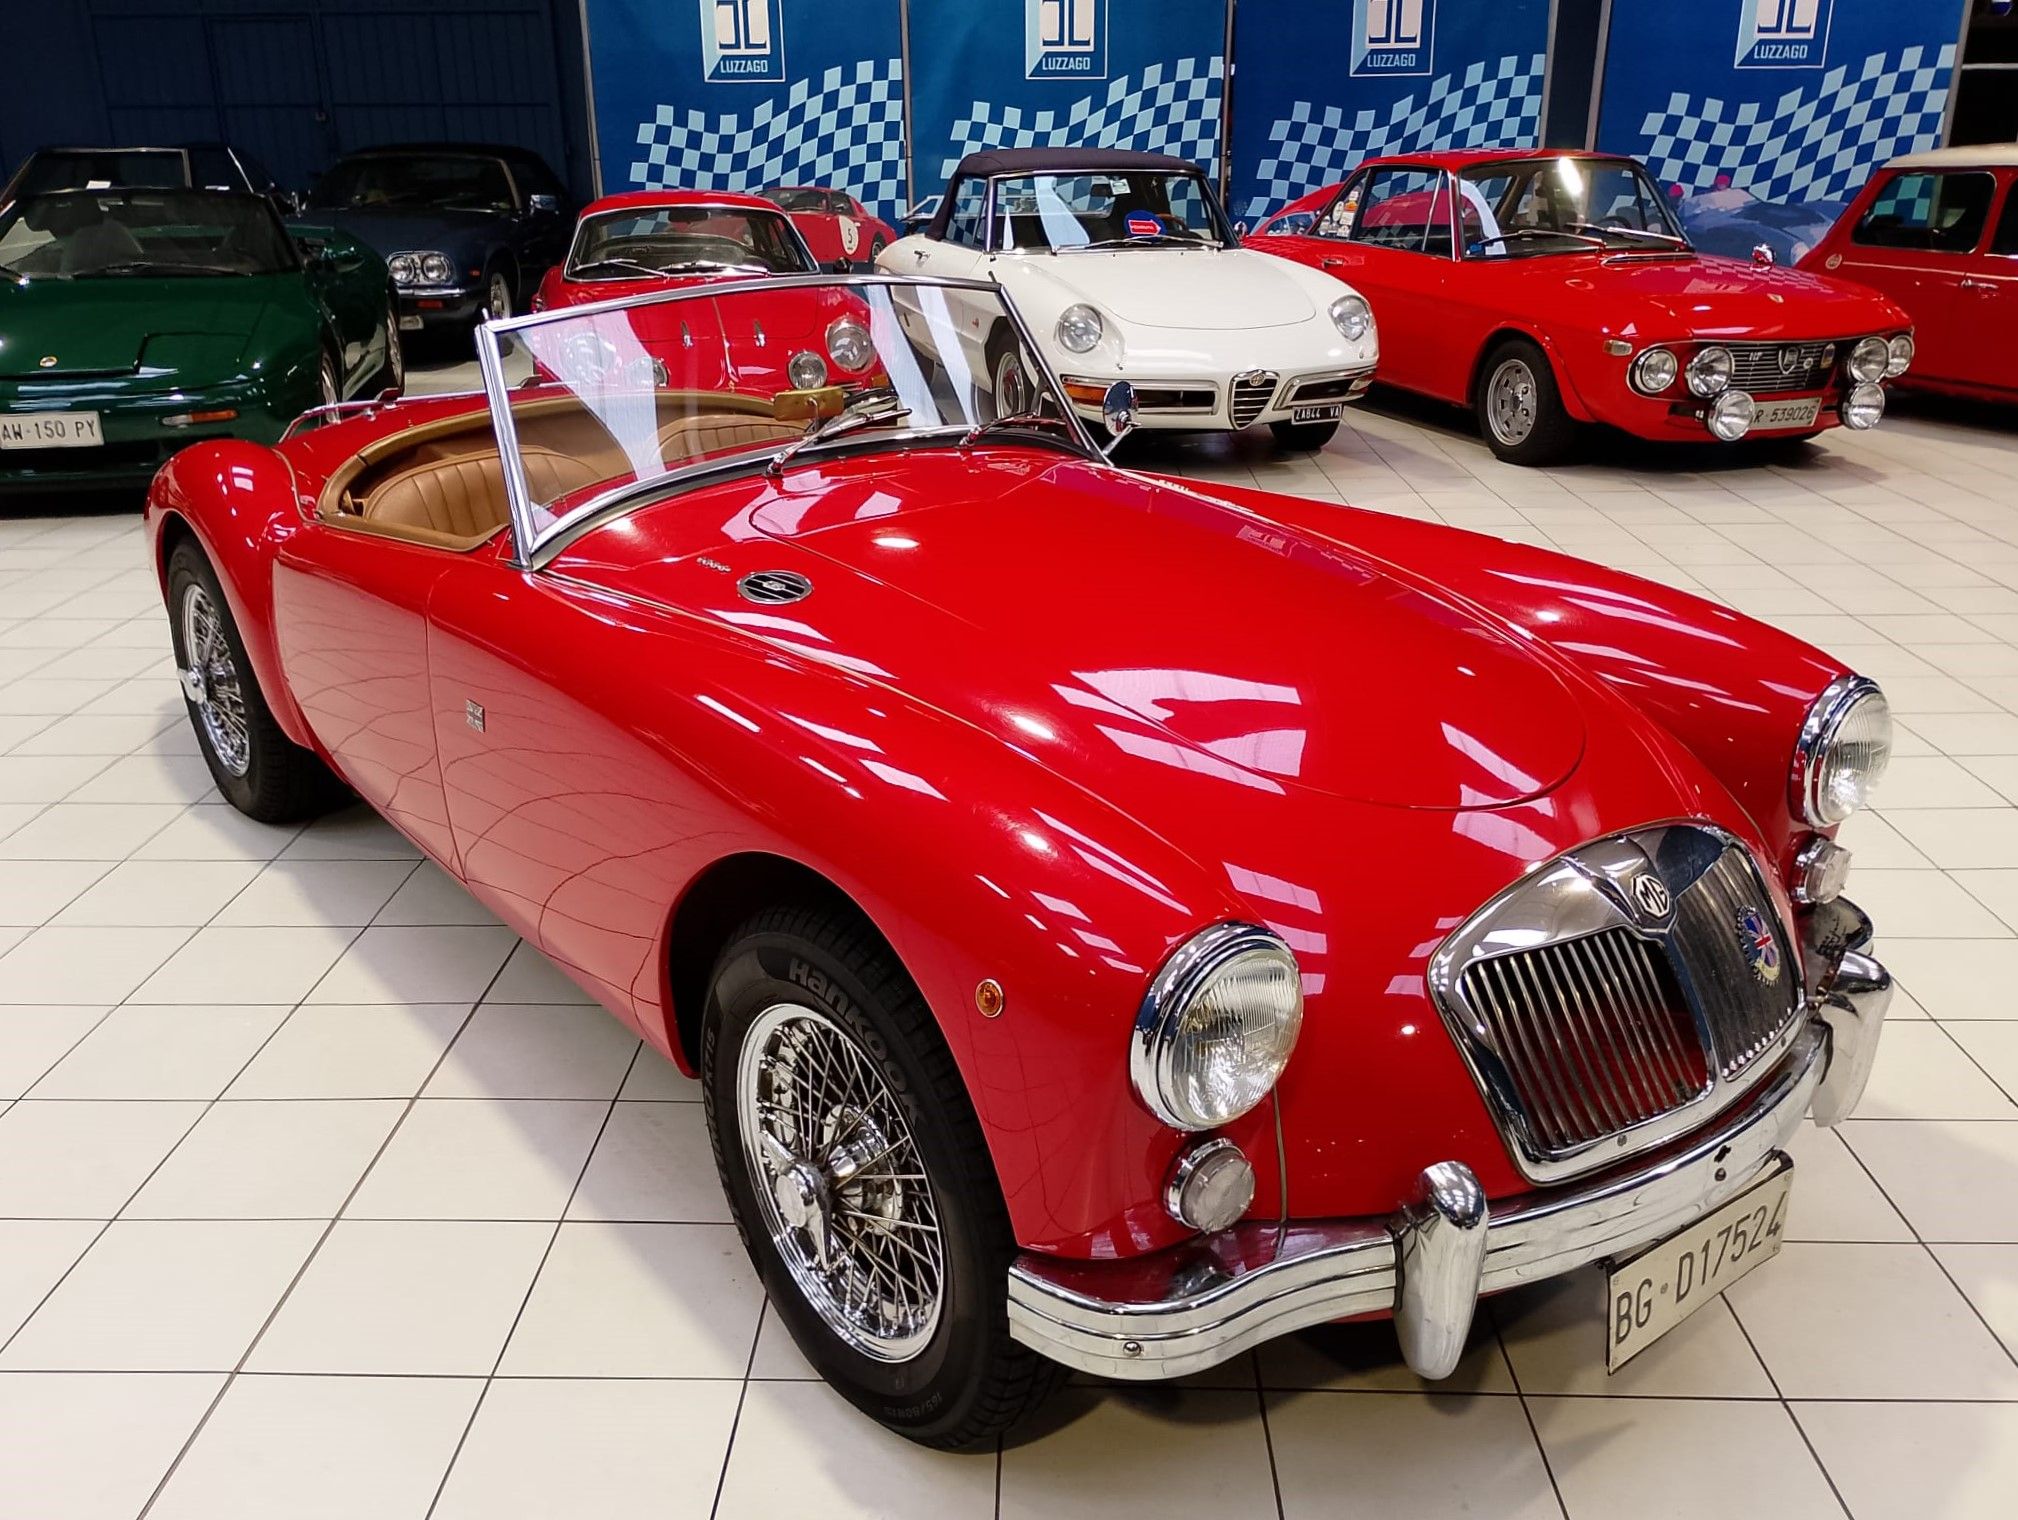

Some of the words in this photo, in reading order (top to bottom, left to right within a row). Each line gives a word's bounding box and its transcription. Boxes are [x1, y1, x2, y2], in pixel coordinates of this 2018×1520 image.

[1754, 45, 1808, 59] LUZZAGO
[720, 60, 768, 73] LUZZAGO
[1042, 57, 1091, 70] LUZZAGO
[1367, 54, 1416, 67] LUZZAGO
[1330, 405, 1340, 418] VA
[34, 420, 66, 439] 150
[75, 419, 95, 438] PY
[1639, 878, 1667, 914] MG
[788, 956, 927, 1128] Hankook
[1615, 1277, 1652, 1345] BG
[1675, 1190, 1787, 1304] D17524
